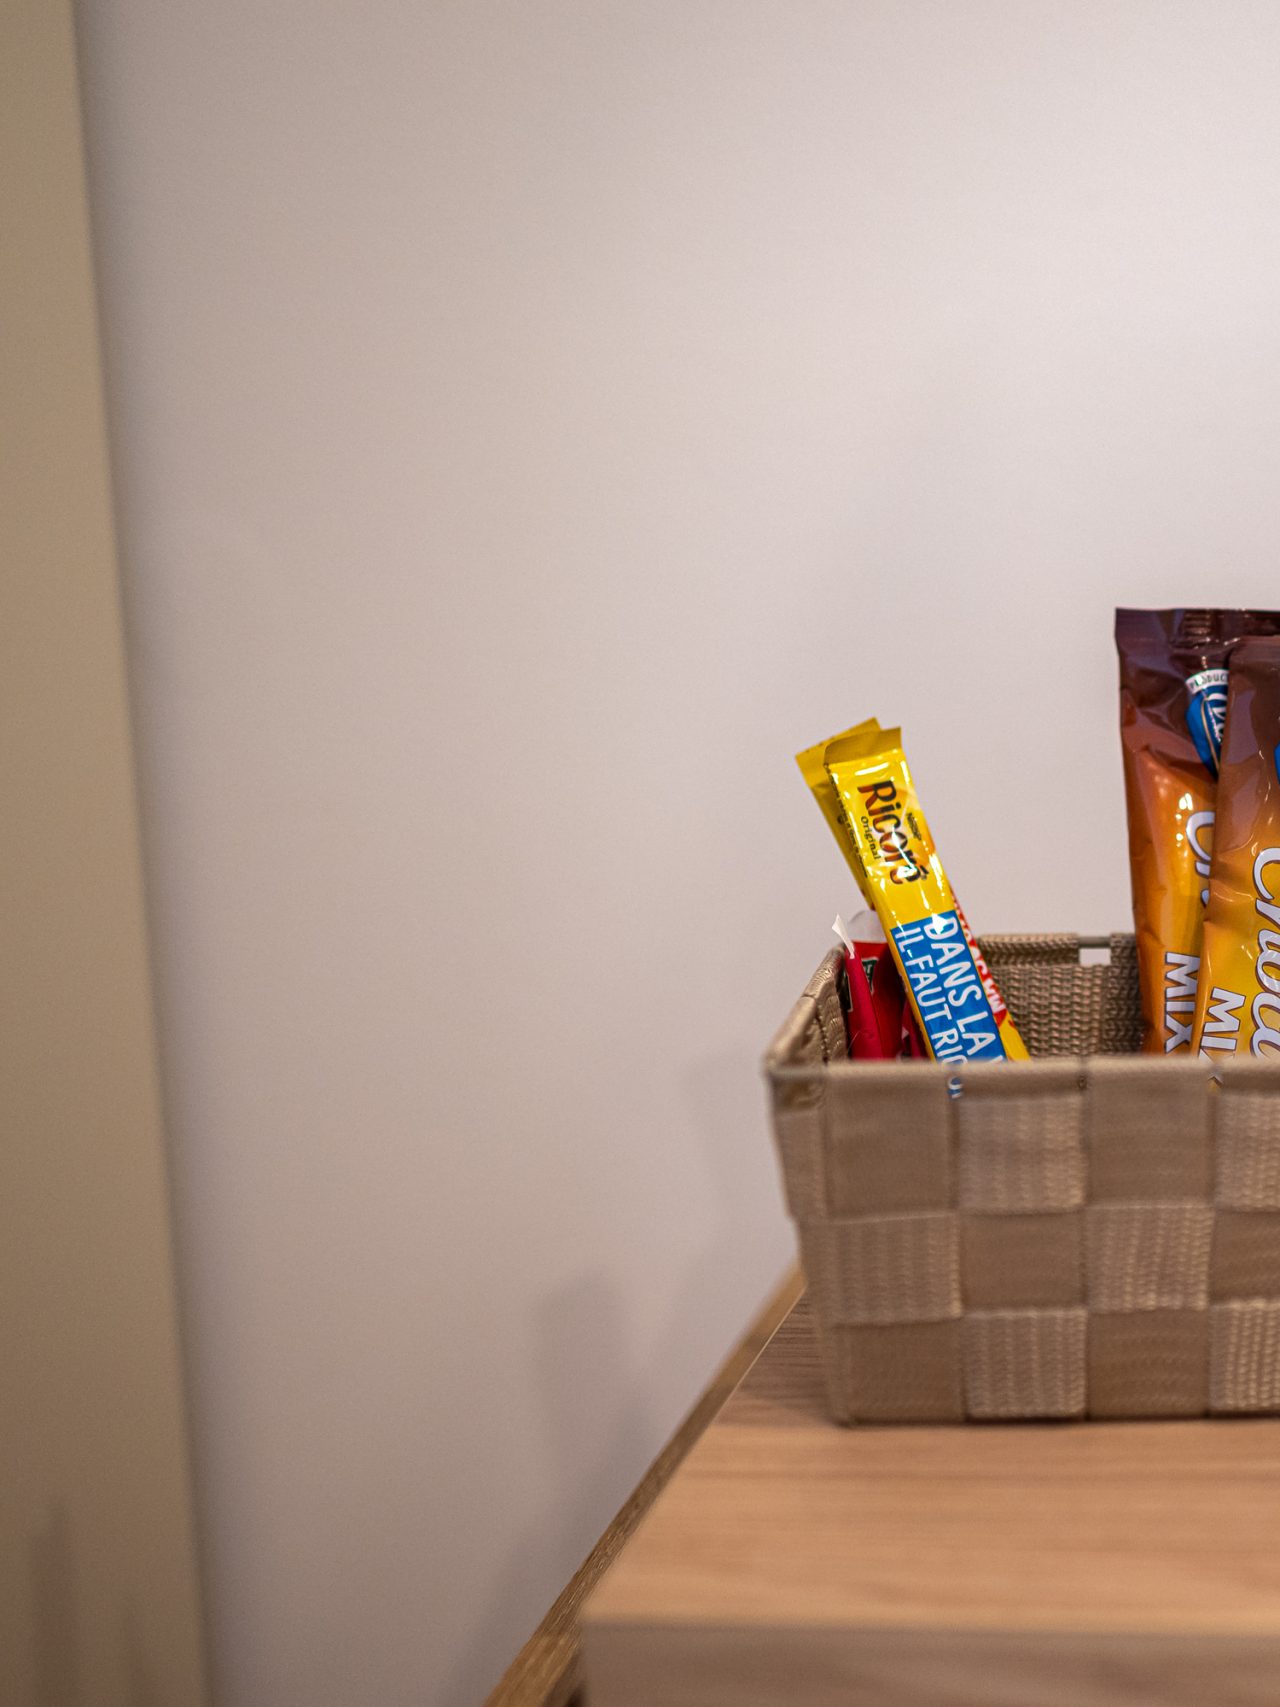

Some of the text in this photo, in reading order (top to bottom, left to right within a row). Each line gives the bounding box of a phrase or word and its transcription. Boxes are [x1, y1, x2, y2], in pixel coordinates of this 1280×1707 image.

[861, 816, 881, 860] Original
[895, 927, 924, 953] IL
[905, 954, 952, 1022] FAUT
[923, 916, 982, 1007] DANS
[956, 1011, 996, 1056] LA
